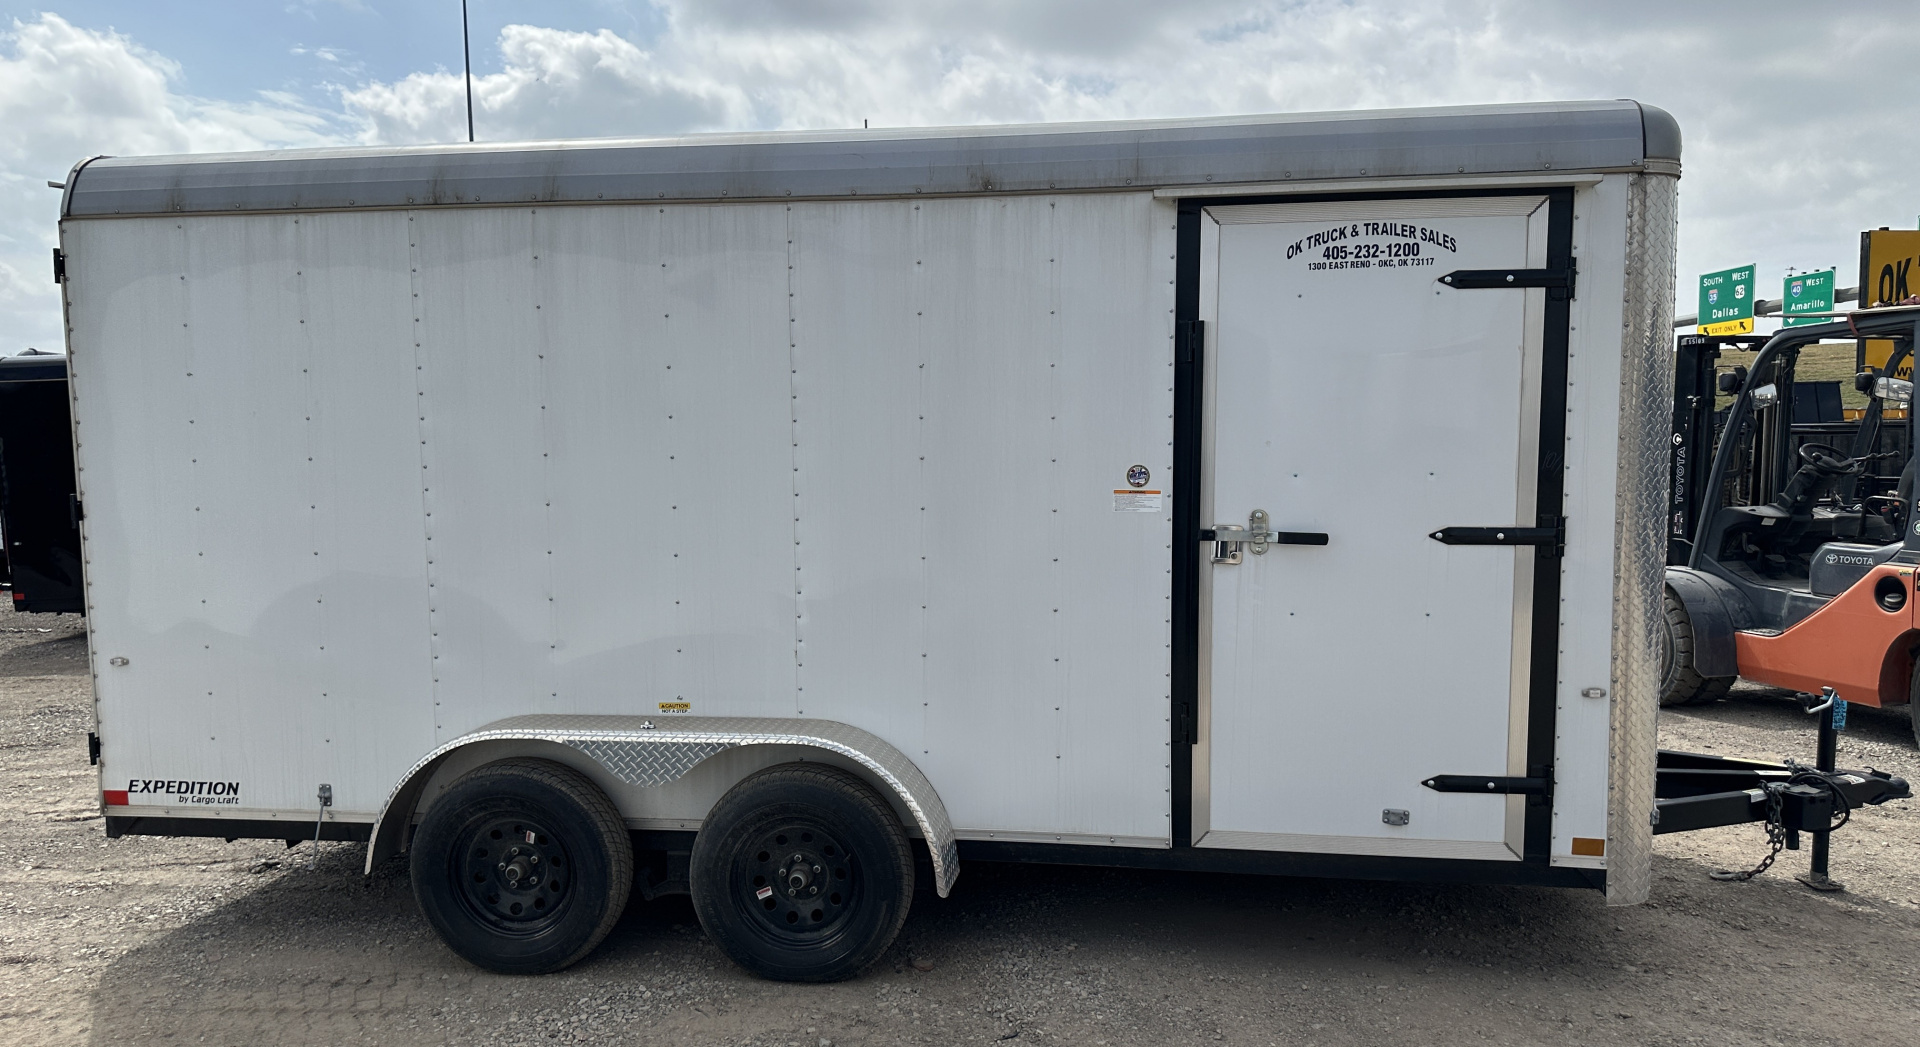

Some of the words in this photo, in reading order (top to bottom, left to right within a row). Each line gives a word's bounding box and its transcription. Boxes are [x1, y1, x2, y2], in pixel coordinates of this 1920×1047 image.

[1286, 239, 1303, 260] OK
[1306, 226, 1348, 250] TRUCK
[1350, 224, 1360, 237] &
[1363, 222, 1417, 239] TRAILER
[1420, 227, 1457, 253] SALES
[1323, 242, 1420, 260] 405-232-1200
[1308, 262, 1327, 271] 1300
[1328, 261, 1348, 270] EAST
[1350, 260, 1371, 268] RENO
[1378, 259, 1396, 269] OKC,
[1398, 258, 1409, 267] OK
[1411, 257, 1435, 267] 73117
[1703, 277, 1723, 287] SOUTH
[1732, 271, 1750, 281] WEST
[1805, 278, 1824, 286] WEST
[1879, 257, 1912, 304] OK
[1709, 293, 1717, 301] 35
[1736, 287, 1744, 296] 62
[1790, 300, 1825, 311] Amarillo
[1712, 308, 1739, 318] Dallas
[1675, 446, 1686, 504] TOYOTA
[1838, 555, 1874, 565] TOYOTA
[128, 779, 240, 796] EXPEDITION
[178, 795, 189, 804] by
[191, 796, 216, 805] Cargo
